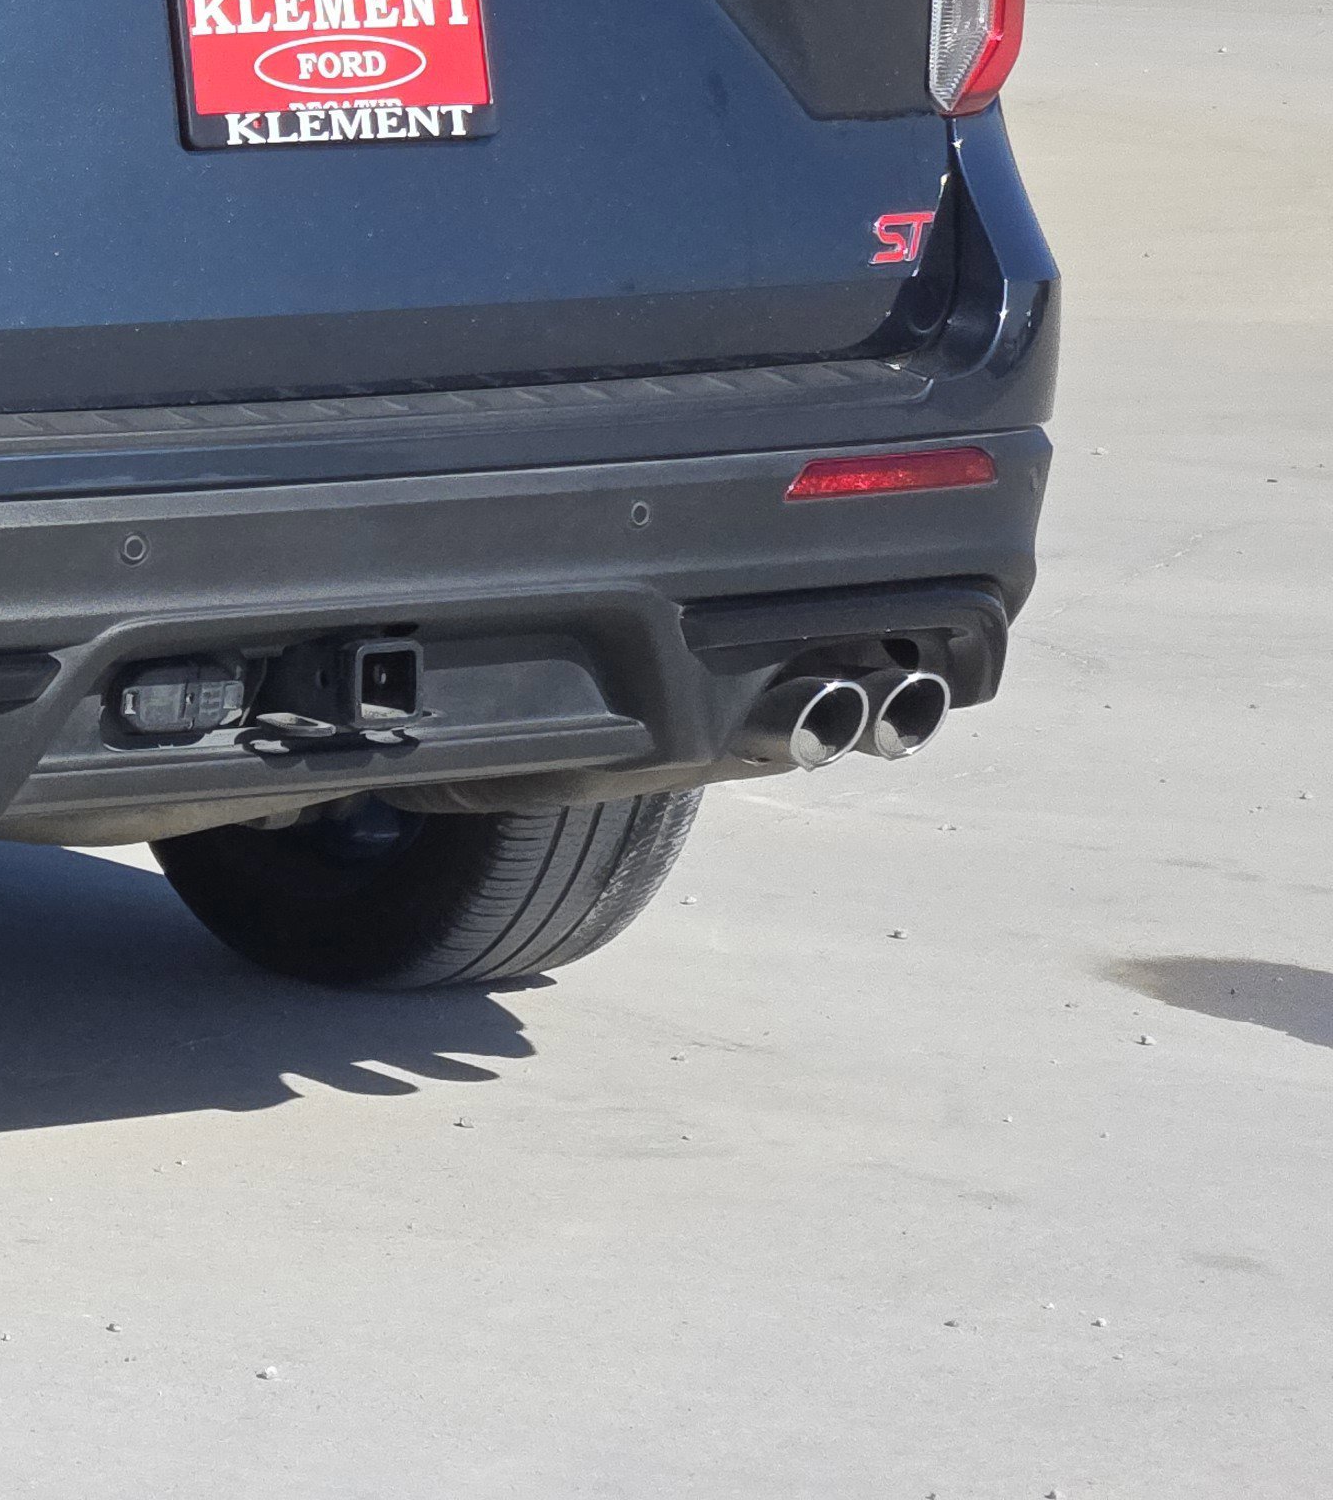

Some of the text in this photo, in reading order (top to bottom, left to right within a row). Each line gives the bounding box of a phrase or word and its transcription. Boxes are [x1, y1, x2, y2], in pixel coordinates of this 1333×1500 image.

[296, 50, 387, 80] FORD
[224, 105, 473, 146] KLEMENT
[871, 211, 935, 264] ST
